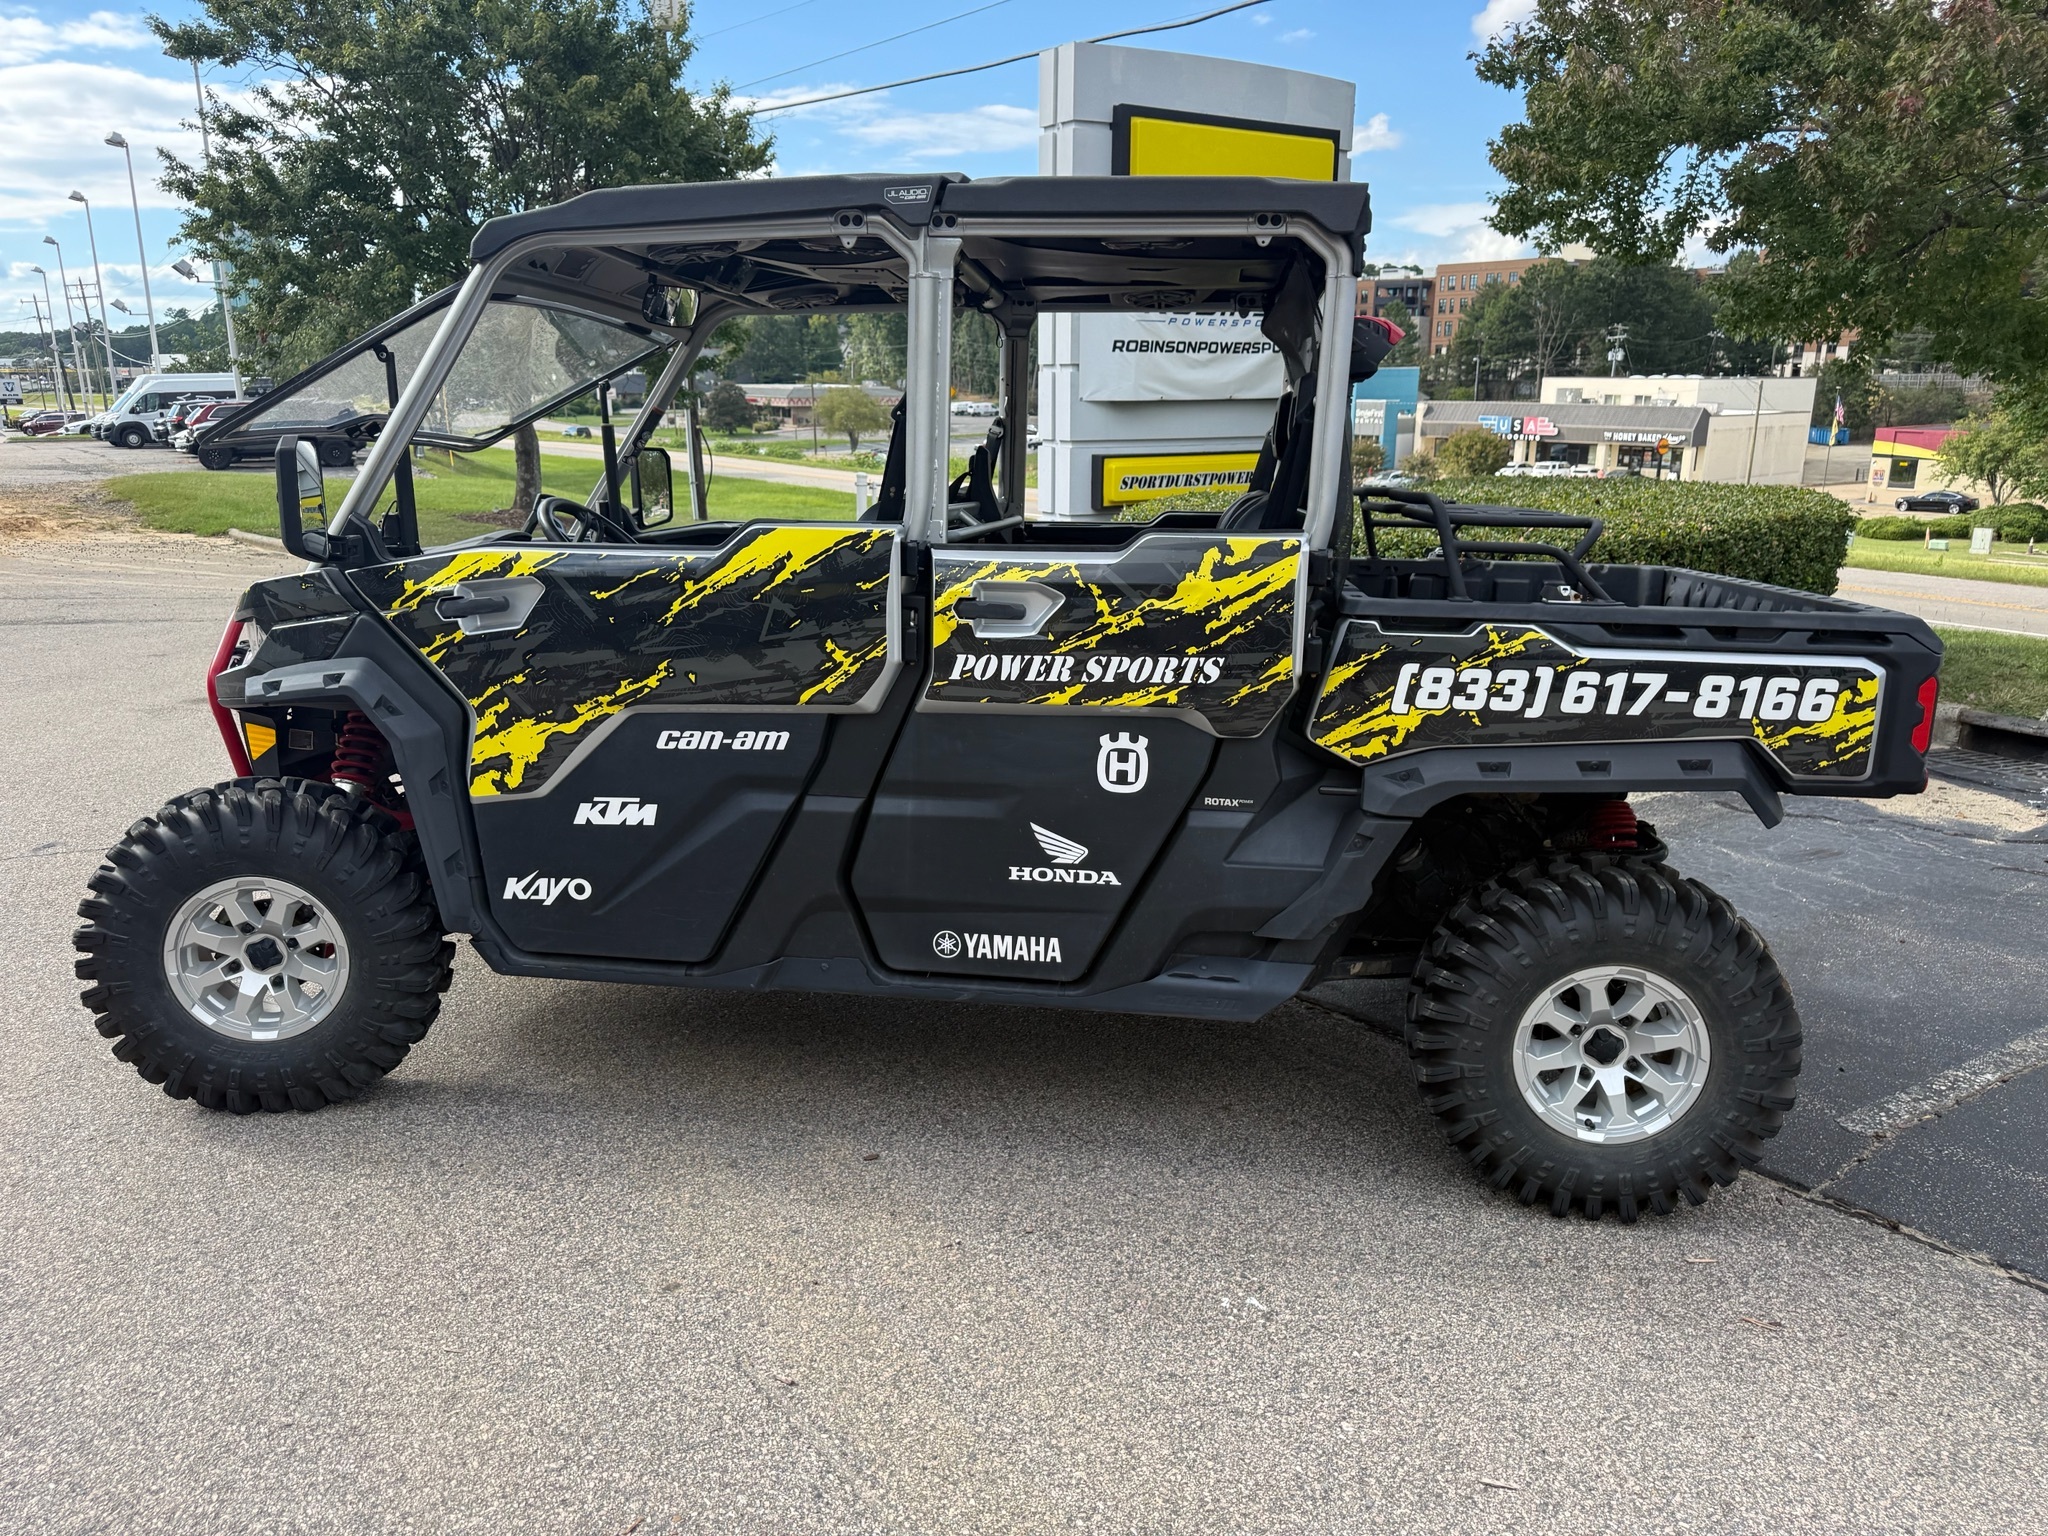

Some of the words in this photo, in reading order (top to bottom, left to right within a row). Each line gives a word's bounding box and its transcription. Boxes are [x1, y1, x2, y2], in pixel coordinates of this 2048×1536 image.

[899, 188, 927, 196] AUDIO
[1499, 418, 1537, 433] USA
[1612, 432, 1637, 442] HONEY
[1637, 432, 1662, 442] BAKED
[1120, 471, 1255, 490] SPORTDURSTPOWER
[949, 653, 1075, 683] POWER
[1081, 655, 1226, 684] SPORTS
[1559, 670, 1841, 722] 617-8166
[656, 730, 791, 750] can-am
[573, 796, 658, 826] KTM
[1204, 796, 1239, 807] ROTAX
[1008, 866, 1122, 886] HONDA
[964, 932, 1062, 963] YAMAHA
